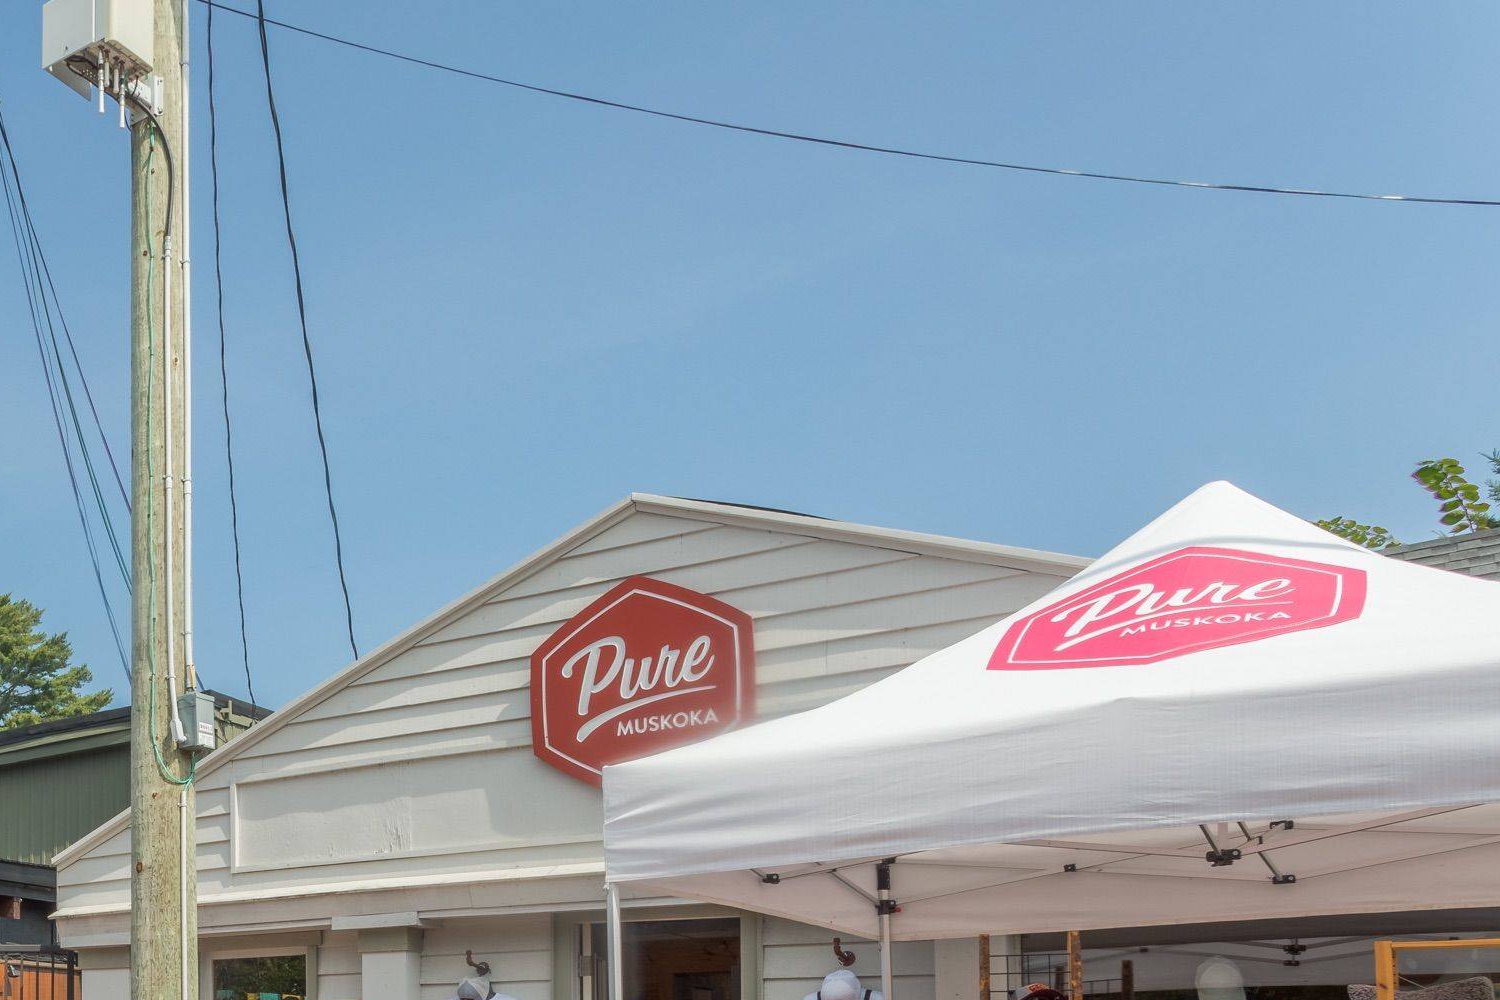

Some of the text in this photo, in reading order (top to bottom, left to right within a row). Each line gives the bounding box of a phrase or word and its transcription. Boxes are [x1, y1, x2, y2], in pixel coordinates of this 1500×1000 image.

[1050, 578, 1299, 638] Pure
[1119, 610, 1291, 637] MUSKOKA
[561, 635, 715, 716] Pure
[616, 707, 719, 737] MUSKOKA
